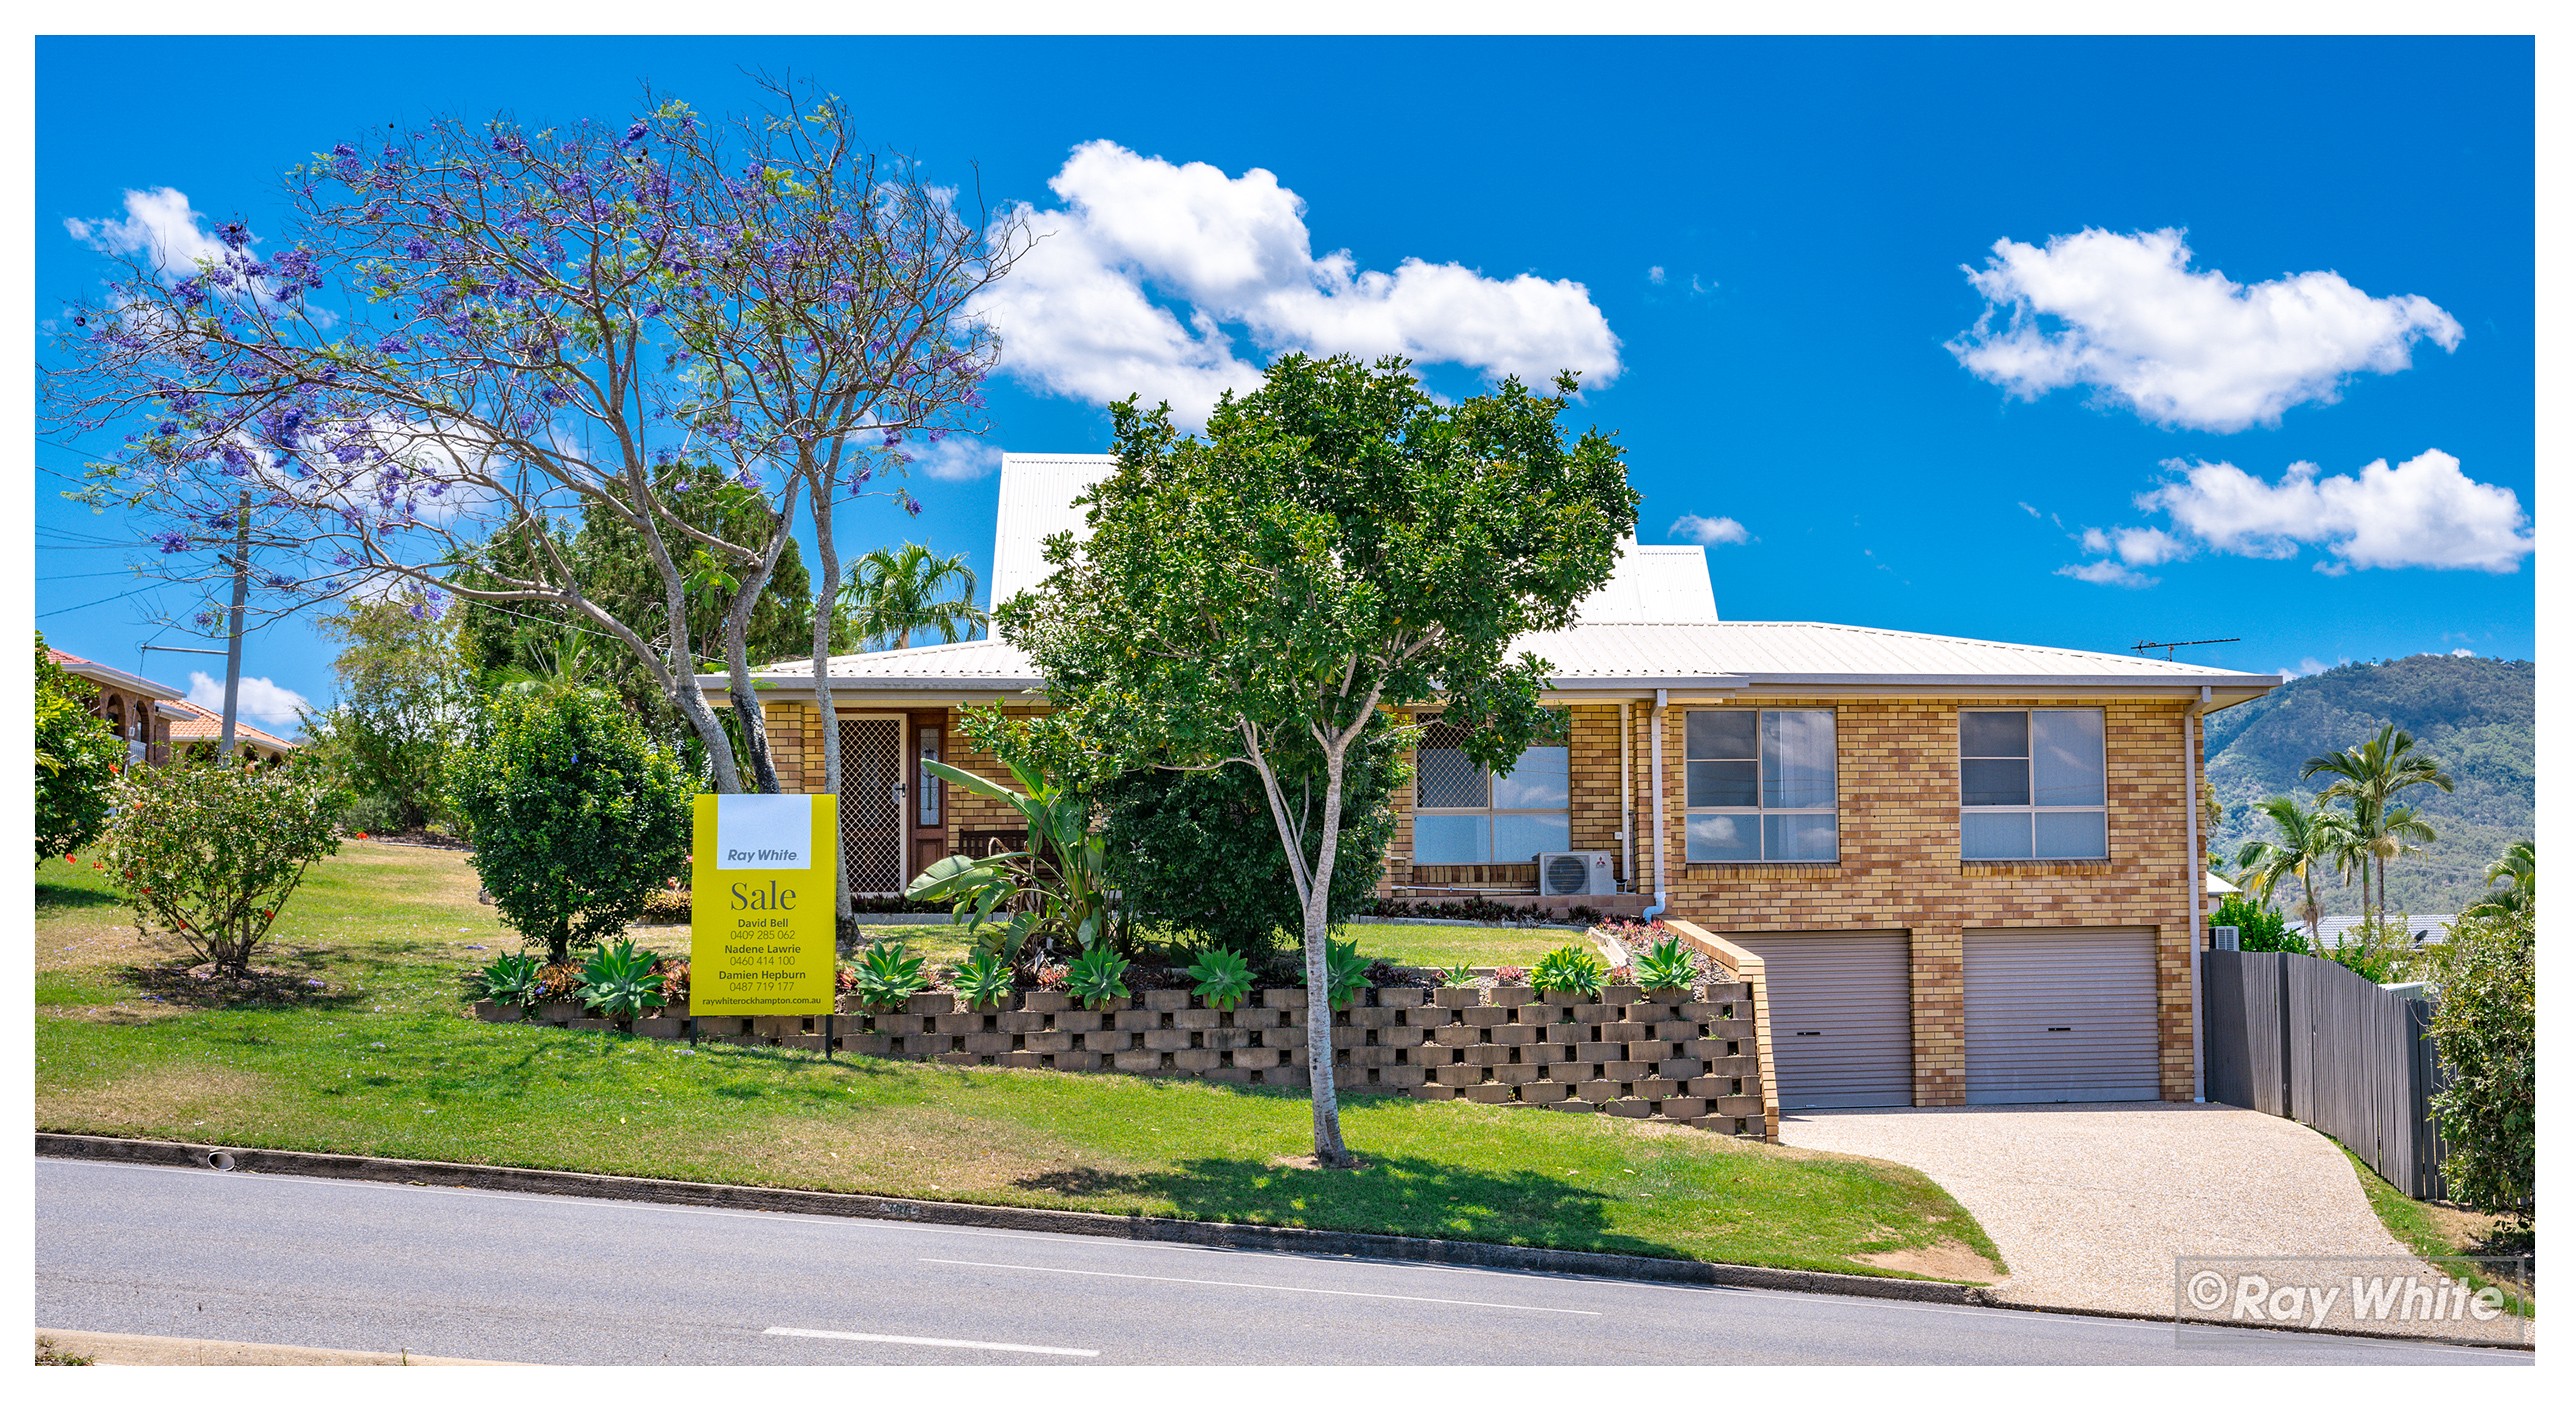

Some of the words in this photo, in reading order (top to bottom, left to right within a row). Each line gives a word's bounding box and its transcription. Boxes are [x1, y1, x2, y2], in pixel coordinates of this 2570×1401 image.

[728, 849, 755, 862] Ray
[731, 880, 796, 910] Sale
[737, 918, 767, 928] David
[770, 918, 789, 928] Bell
[730, 930, 754, 940] 0409
[757, 930, 775, 940] 285
[777, 930, 795, 940] 062
[724, 944, 765, 954] Nadene
[767, 944, 801, 954] Lawrie
[730, 956, 754, 966] 0460
[756, 956, 775, 966] 414
[777, 956, 795, 966] 100
[719, 970, 758, 980] Damien
[761, 970, 806, 981] Hepburn
[729, 982, 753, 992] 0487
[756, 982, 774, 992] 719
[777, 982, 794, 991] 177
[702, 997, 821, 1006] raywhiterockhampton.com.au
